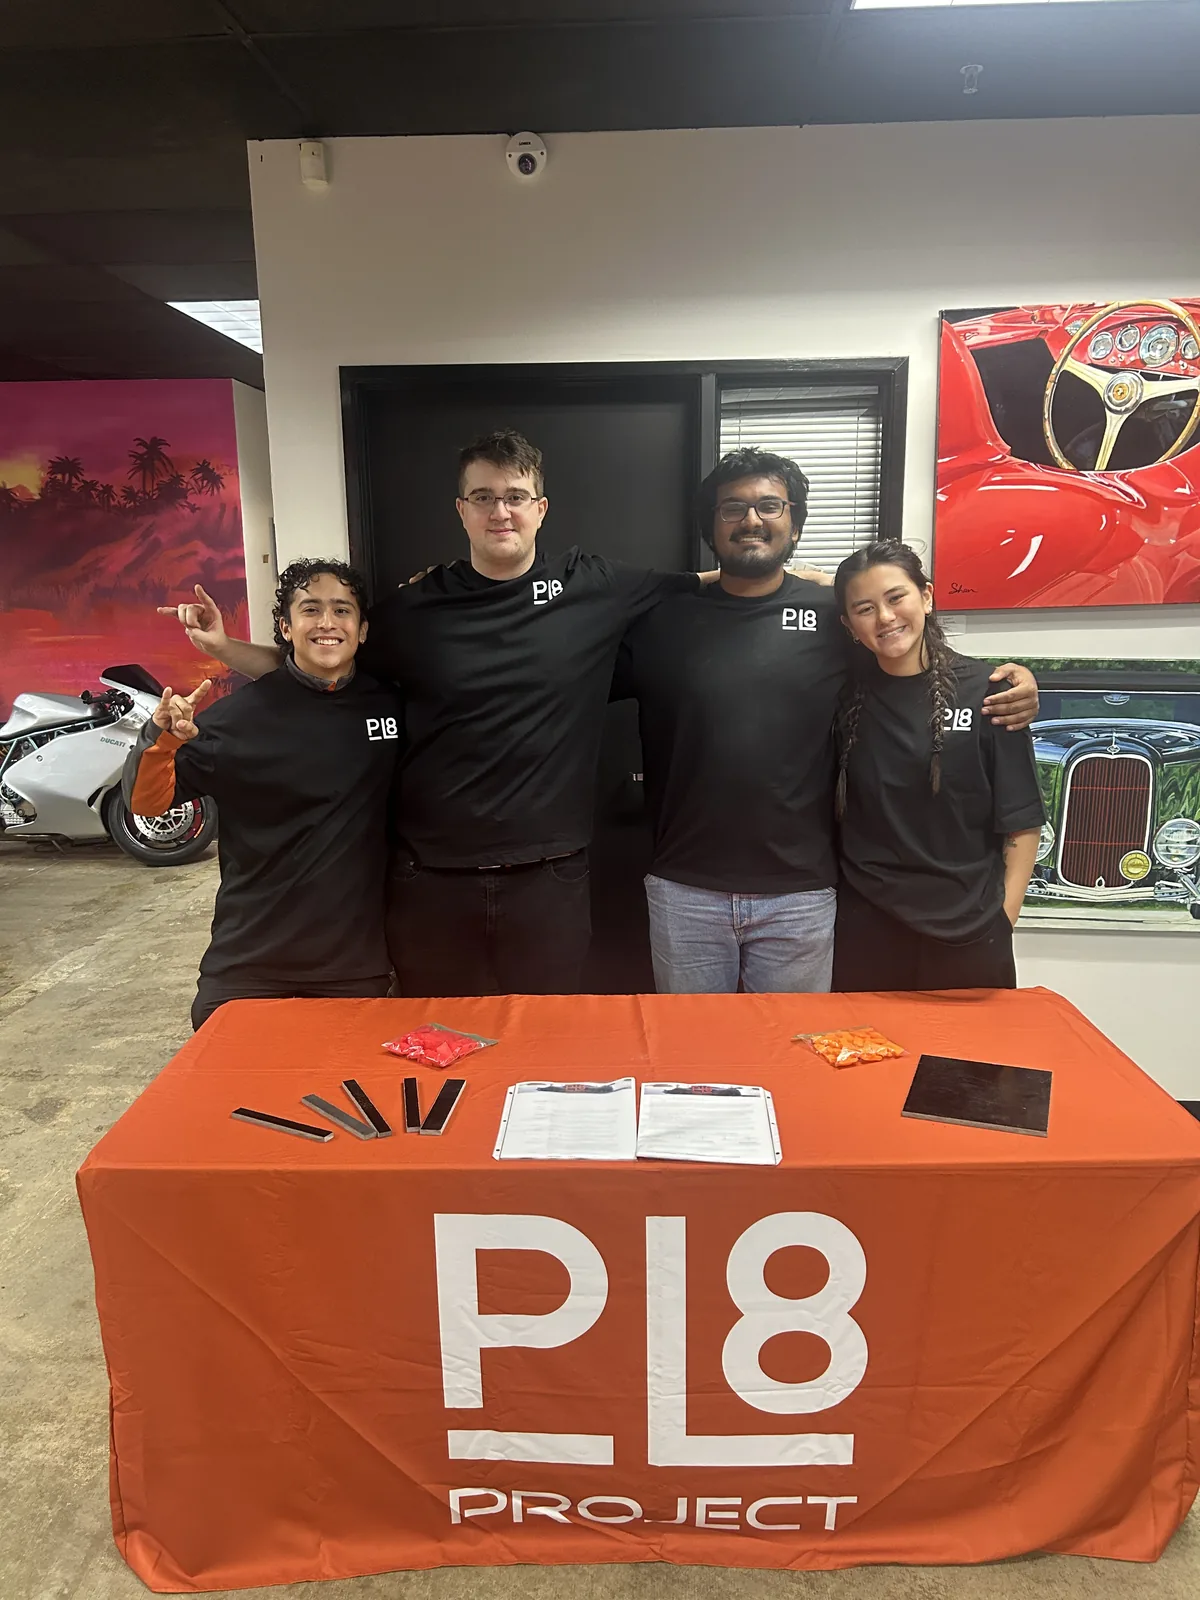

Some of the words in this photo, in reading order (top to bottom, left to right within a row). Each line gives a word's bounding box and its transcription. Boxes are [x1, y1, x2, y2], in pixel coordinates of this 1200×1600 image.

[782, 607, 817, 632] PL8
[365, 716, 399, 741] PL8
[100, 736, 127, 748] DUCATI
[434, 1211, 869, 1467] PL8
[449, 1487, 858, 1531] PROJECT
